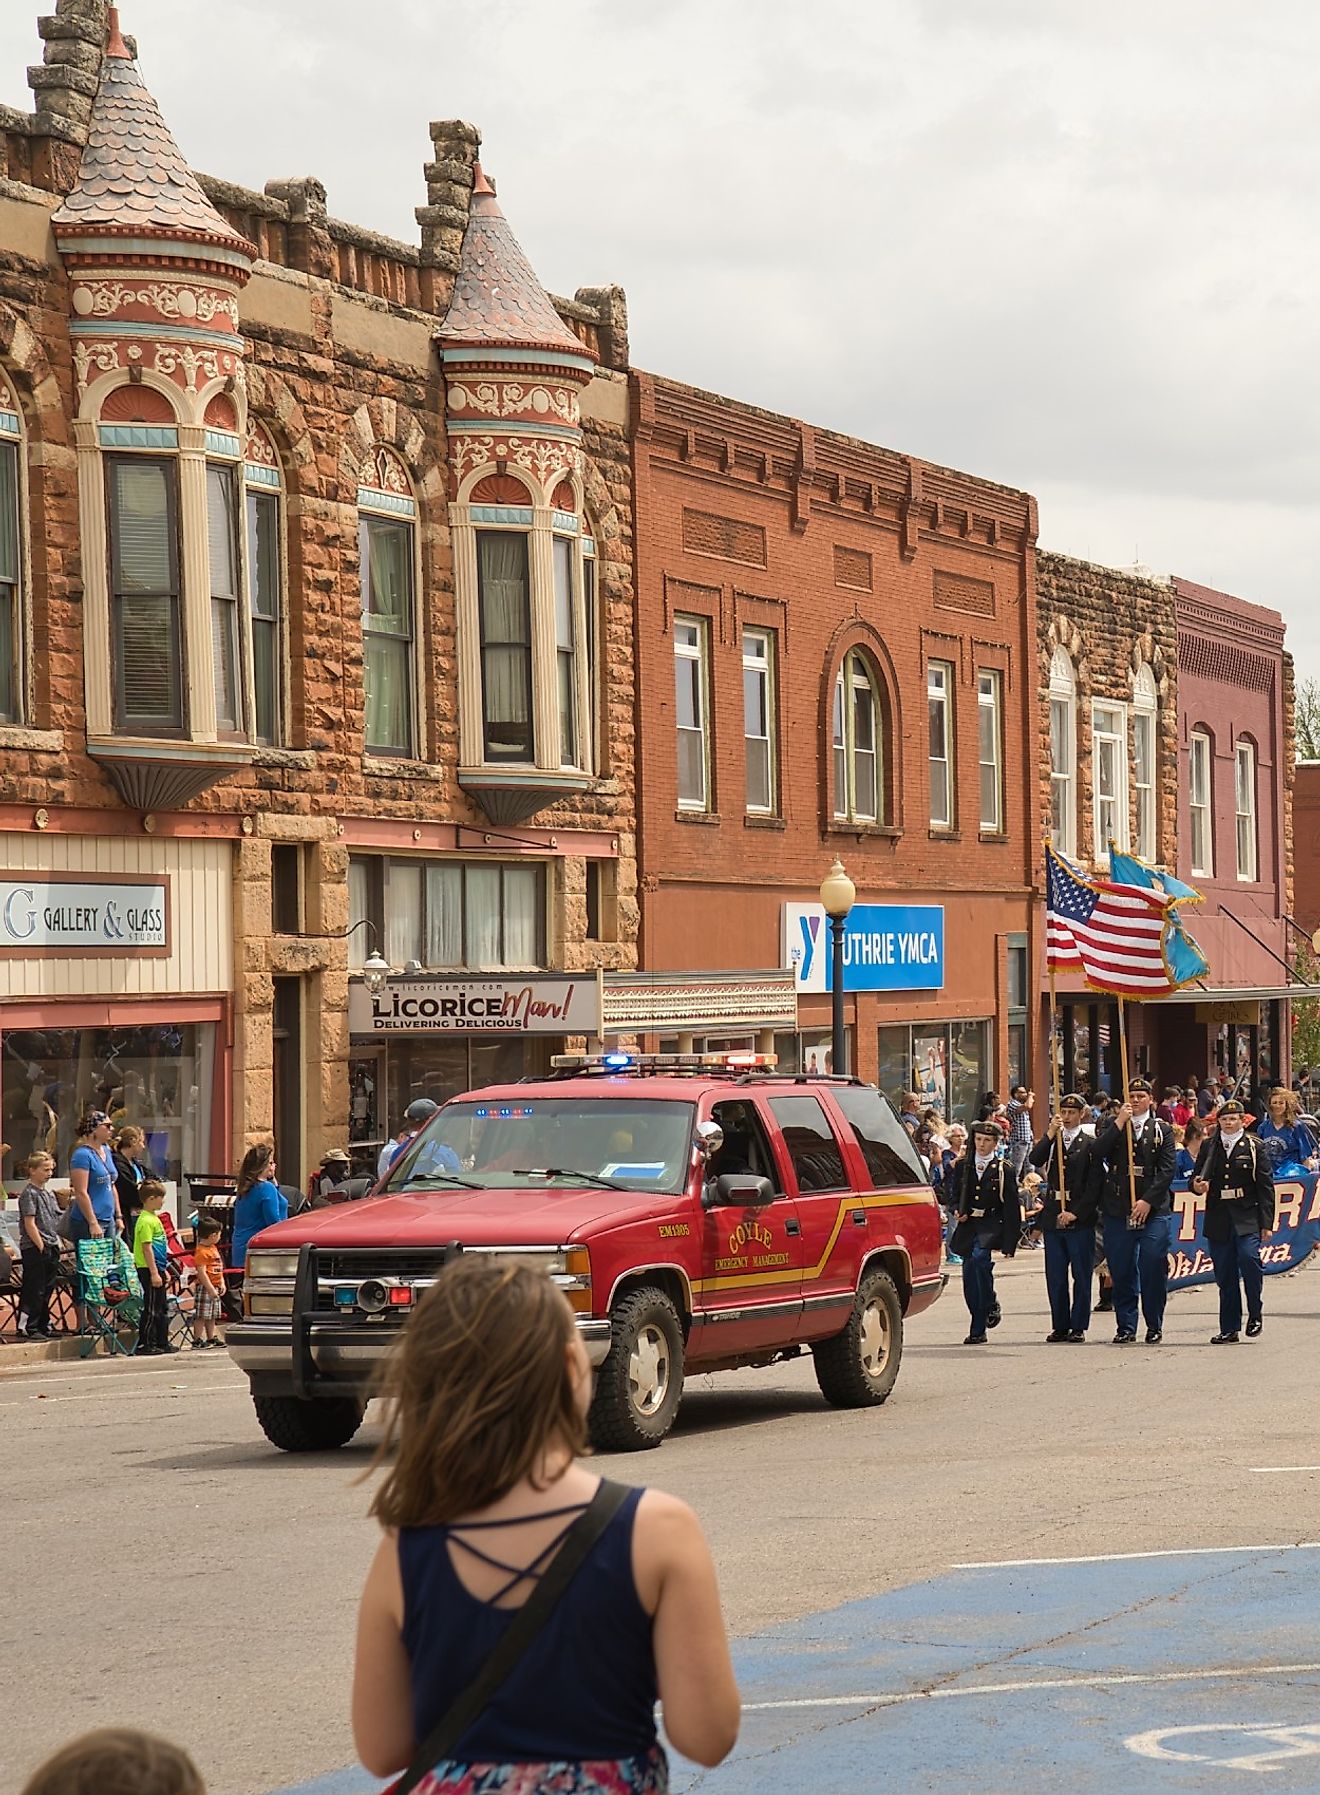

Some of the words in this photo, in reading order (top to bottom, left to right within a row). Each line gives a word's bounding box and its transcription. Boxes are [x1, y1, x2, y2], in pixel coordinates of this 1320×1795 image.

[43, 907, 98, 932] GALLERY
[103, 900, 125, 939] &
[127, 908, 162, 932] GLASS
[128, 933, 163, 942] STUDIO
[831, 932, 895, 966] UTHRIE
[897, 932, 939, 964] YMCA
[500, 984, 574, 1029] Man!
[374, 1019, 450, 1029] DELIVERING
[455, 1018, 522, 1028] DELICIOUS
[729, 1221, 772, 1254] COYLE
[715, 1256, 748, 1271] EMERGENCY
[752, 1252, 789, 1267] MANAGEMENT
